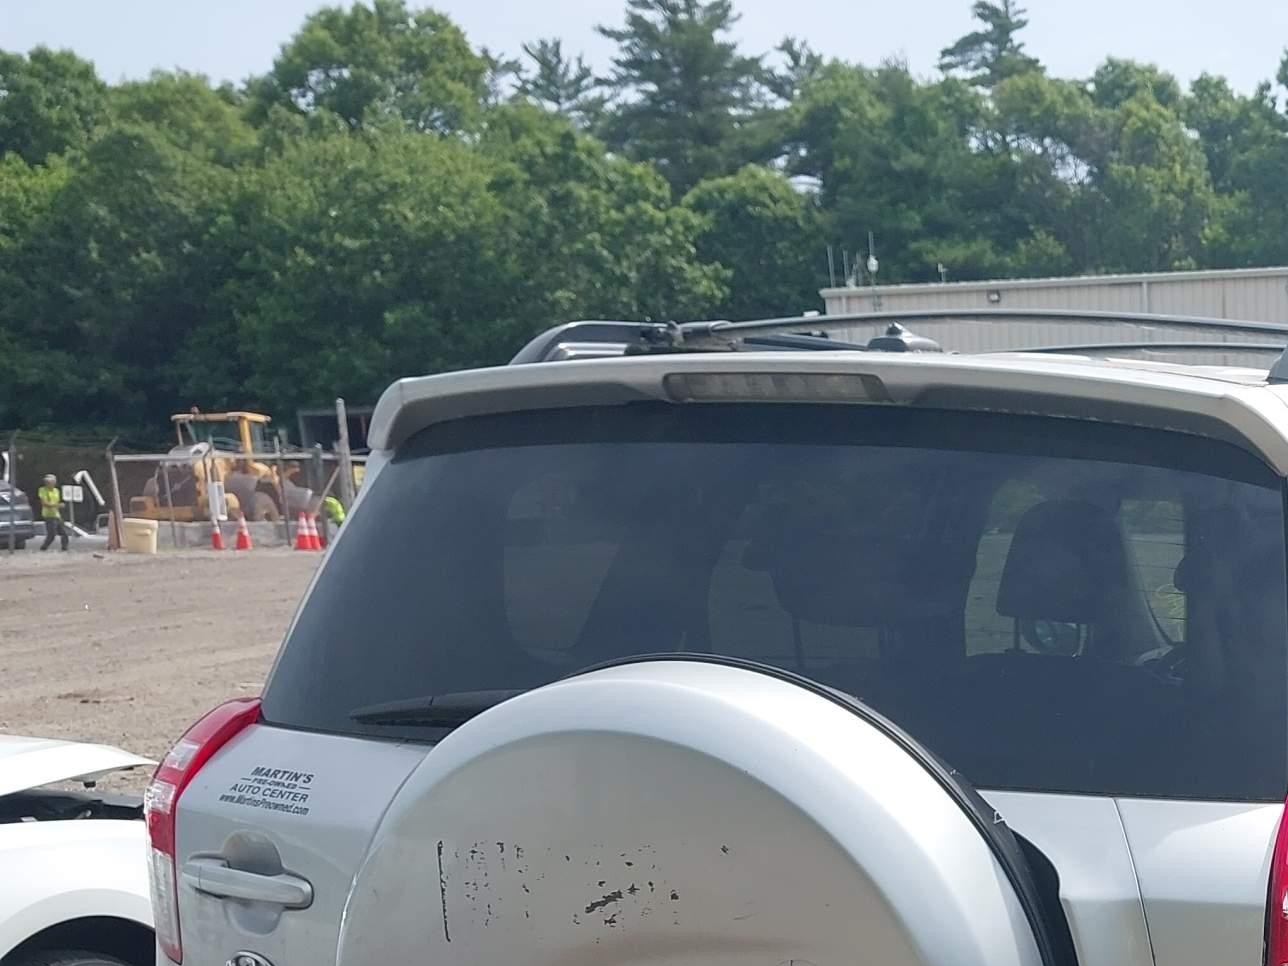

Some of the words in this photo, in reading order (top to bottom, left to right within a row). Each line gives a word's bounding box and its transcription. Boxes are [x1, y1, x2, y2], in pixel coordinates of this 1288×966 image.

[250, 766, 315, 784] MARTIN'S
[251, 777, 299, 790] PRE-OWNED
[230, 783, 261, 795] AUTO
[262, 788, 309, 803] CENTER
